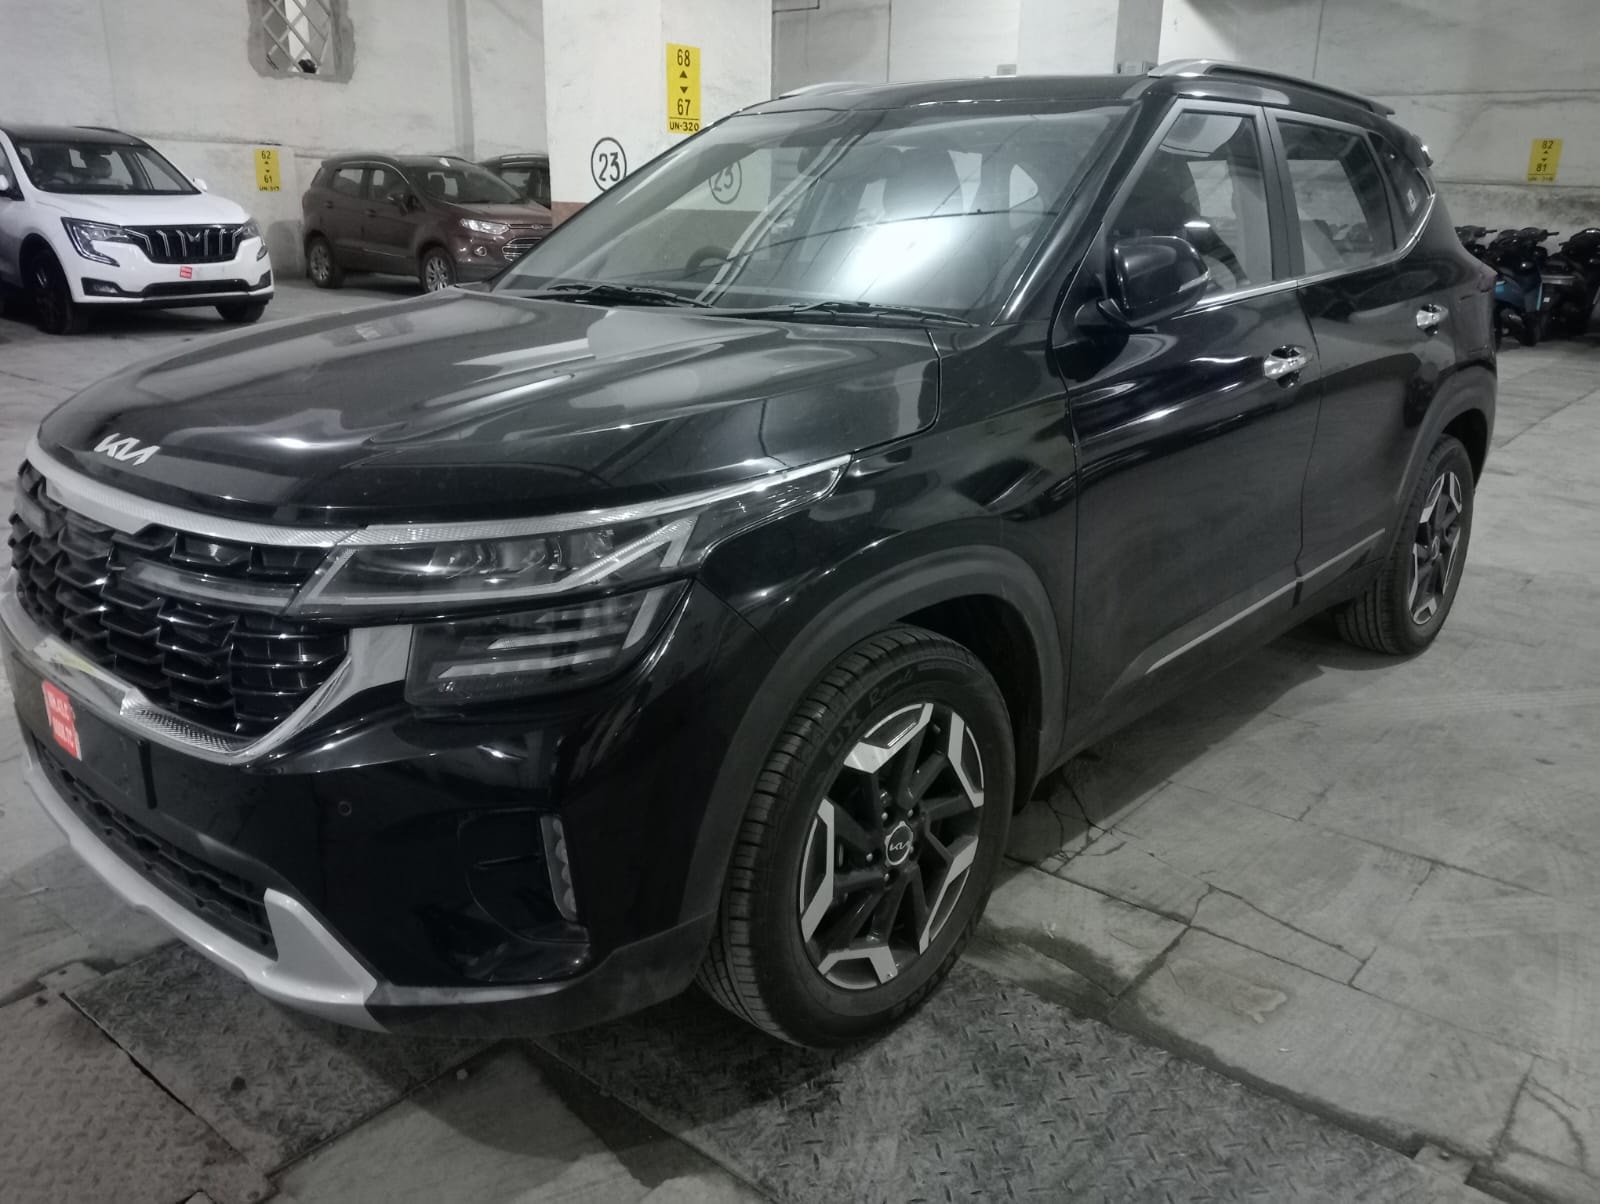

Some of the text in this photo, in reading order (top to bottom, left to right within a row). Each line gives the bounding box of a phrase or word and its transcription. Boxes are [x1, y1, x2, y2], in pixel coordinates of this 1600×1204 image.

[677, 48, 691, 67] 68
[677, 98, 691, 116] 67
[669, 119, 699, 132] UN-320
[1542, 140, 1554, 149] 82
[261, 150, 271, 160] 62
[598, 152, 621, 182] 23
[1536, 163, 1547, 172] 81
[263, 175, 273, 184] 61
[94, 432, 160, 466] KIA
